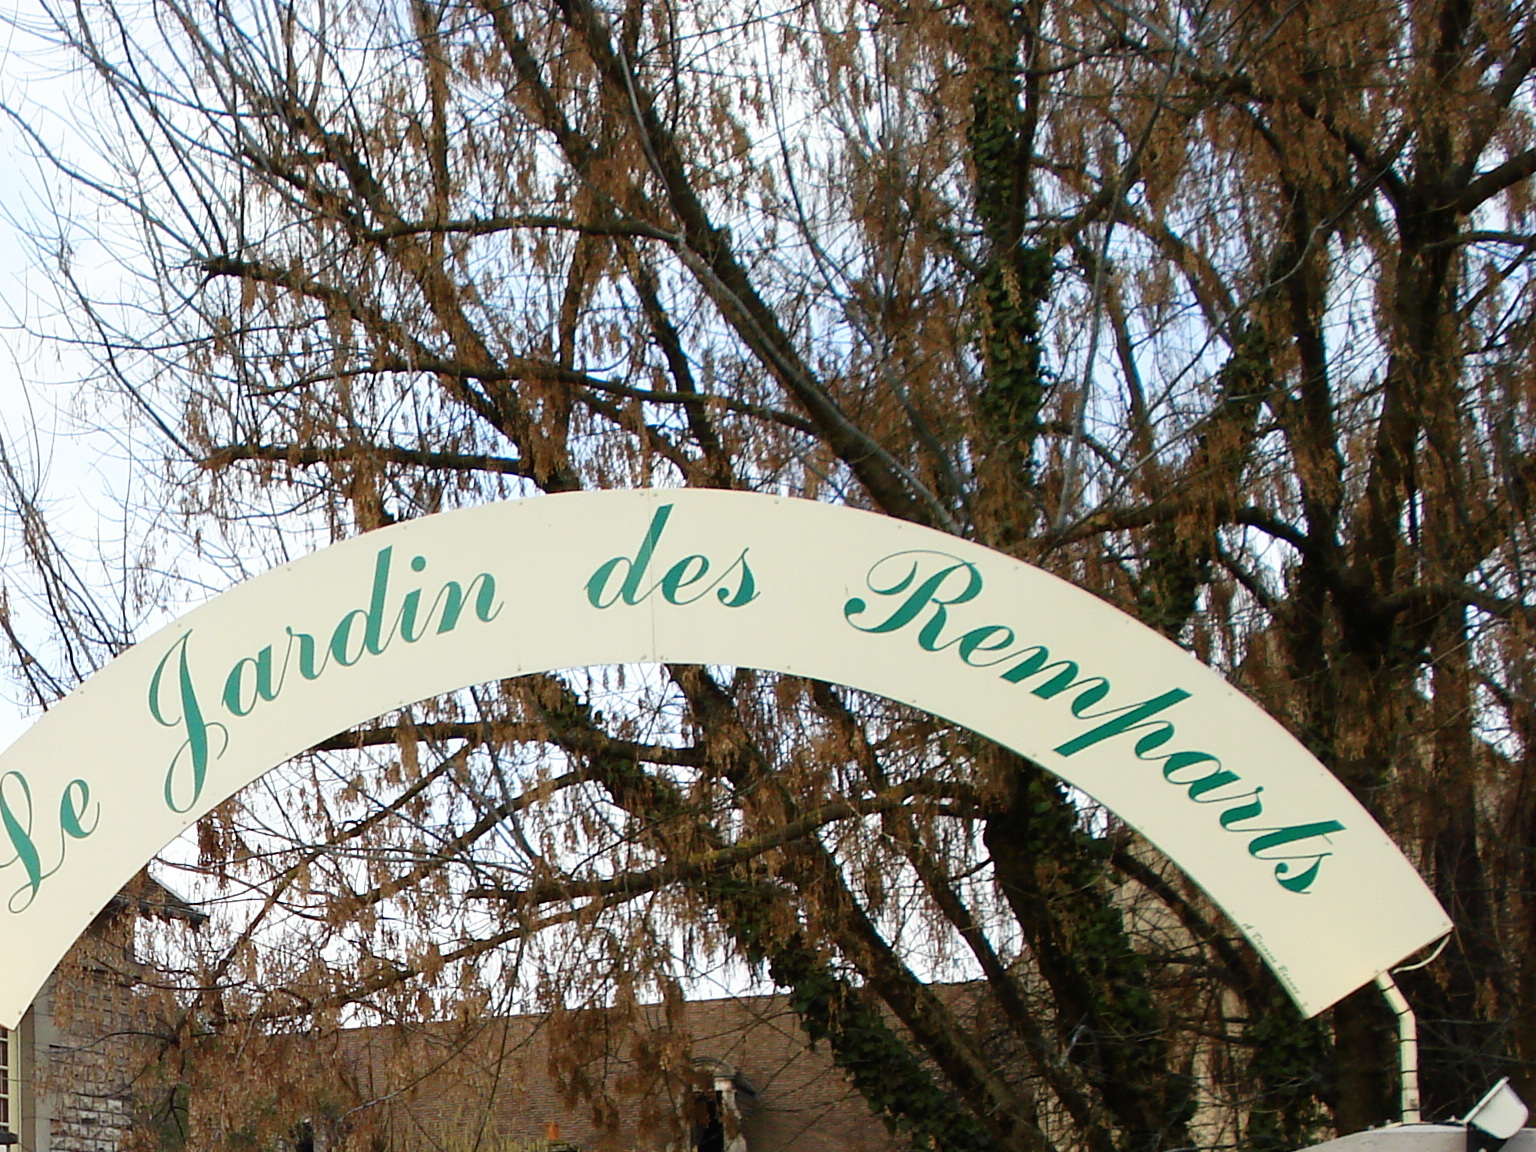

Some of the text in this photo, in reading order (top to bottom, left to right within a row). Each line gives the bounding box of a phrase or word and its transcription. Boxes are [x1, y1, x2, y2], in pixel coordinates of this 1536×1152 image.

[148, 544, 505, 814] Jardin
[583, 503, 762, 610] des
[843, 549, 1348, 895] Remparts
